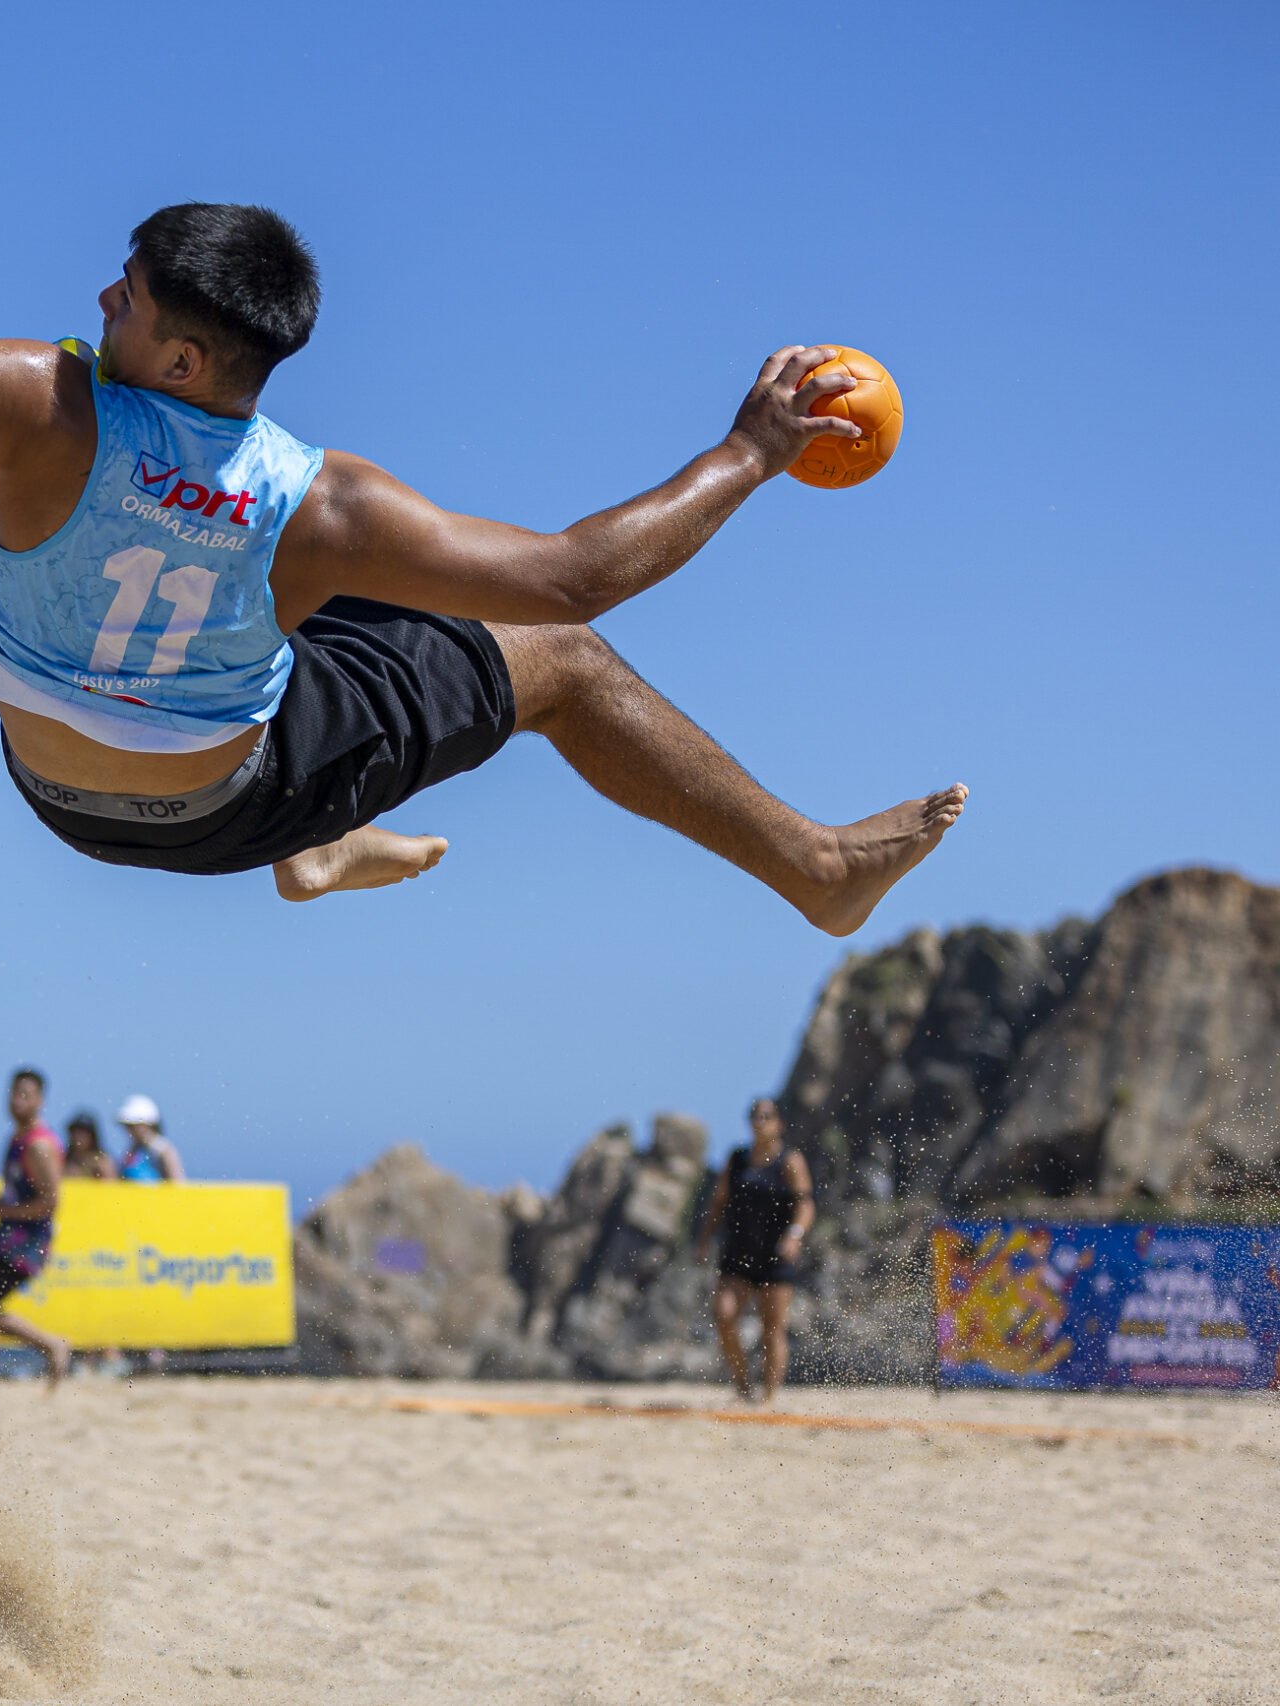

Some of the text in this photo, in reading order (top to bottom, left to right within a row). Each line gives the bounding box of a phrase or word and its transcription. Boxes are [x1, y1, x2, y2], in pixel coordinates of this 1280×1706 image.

[121, 495, 248, 551] ORMAZABAL
[158, 477, 258, 527] prt
[88, 544, 220, 675] 11
[32, 779, 78, 807] TOP
[130, 800, 188, 818] TOP
